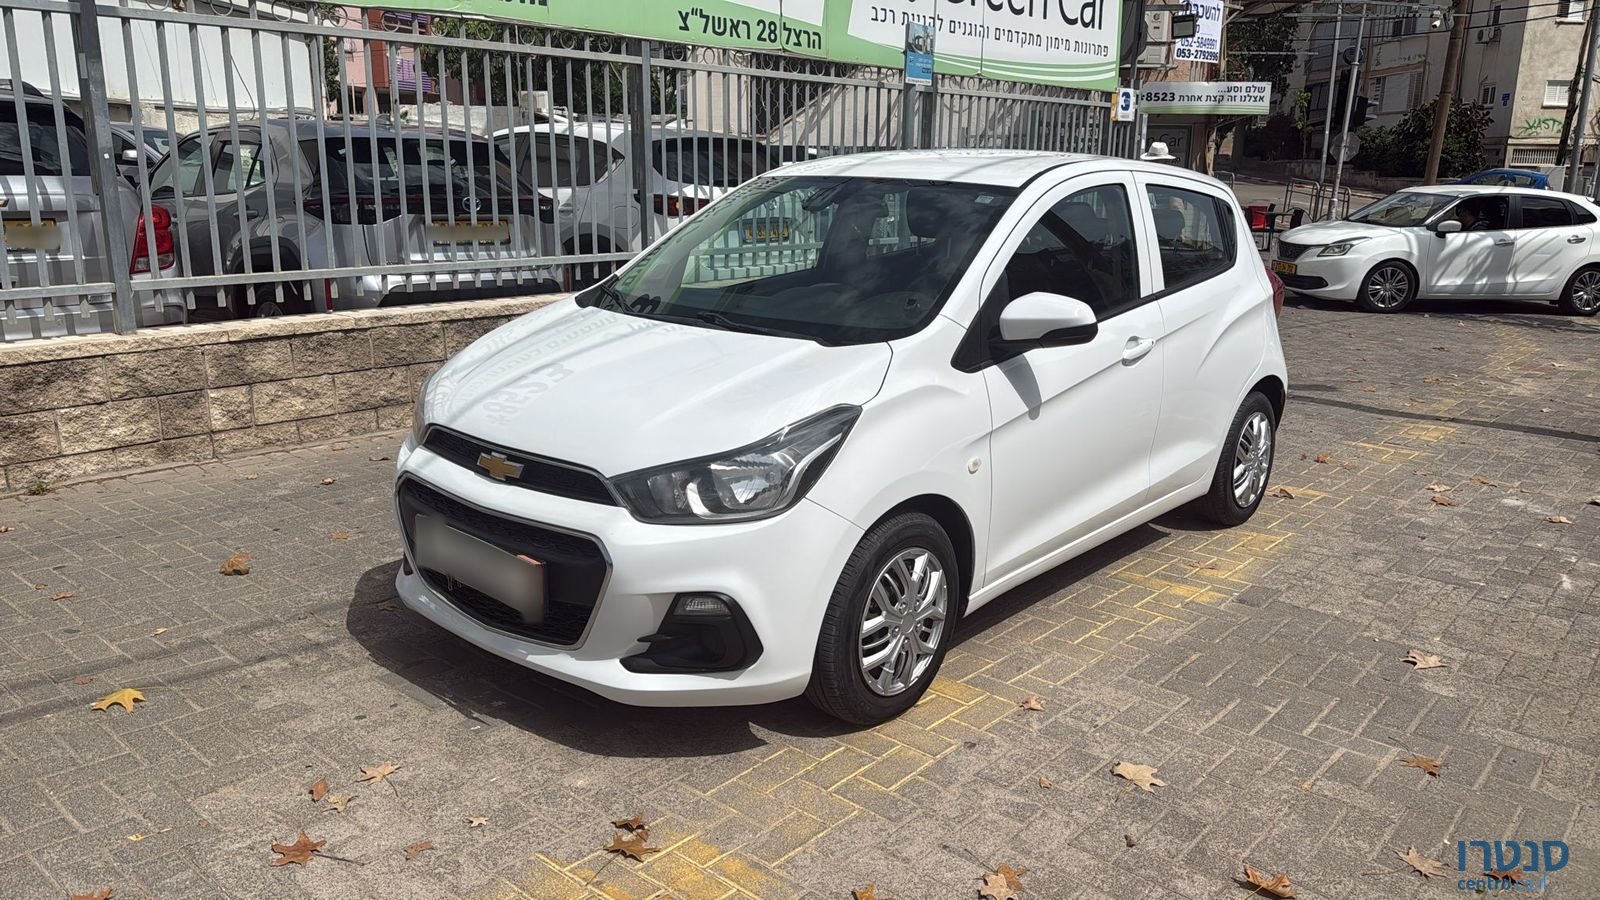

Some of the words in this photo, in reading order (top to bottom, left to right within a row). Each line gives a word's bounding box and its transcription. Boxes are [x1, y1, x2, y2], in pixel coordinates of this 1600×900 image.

[871, 6, 896, 24] רכב
[756, 19, 778, 43] 28
[783, 22, 821, 50] הרצל
[949, 20, 989, 39] והוגנים
[994, 27, 1042, 48] מתקדמים
[1046, 35, 1071, 51] מימון
[1074, 40, 1109, 57] פתרונות
[1245, 85, 1266, 93] שלם
[1178, 94, 1202, 103] אחרת
[1205, 94, 1224, 104] קצת
[1226, 93, 1237, 102] זה
[1240, 93, 1265, 102] אצלנו
